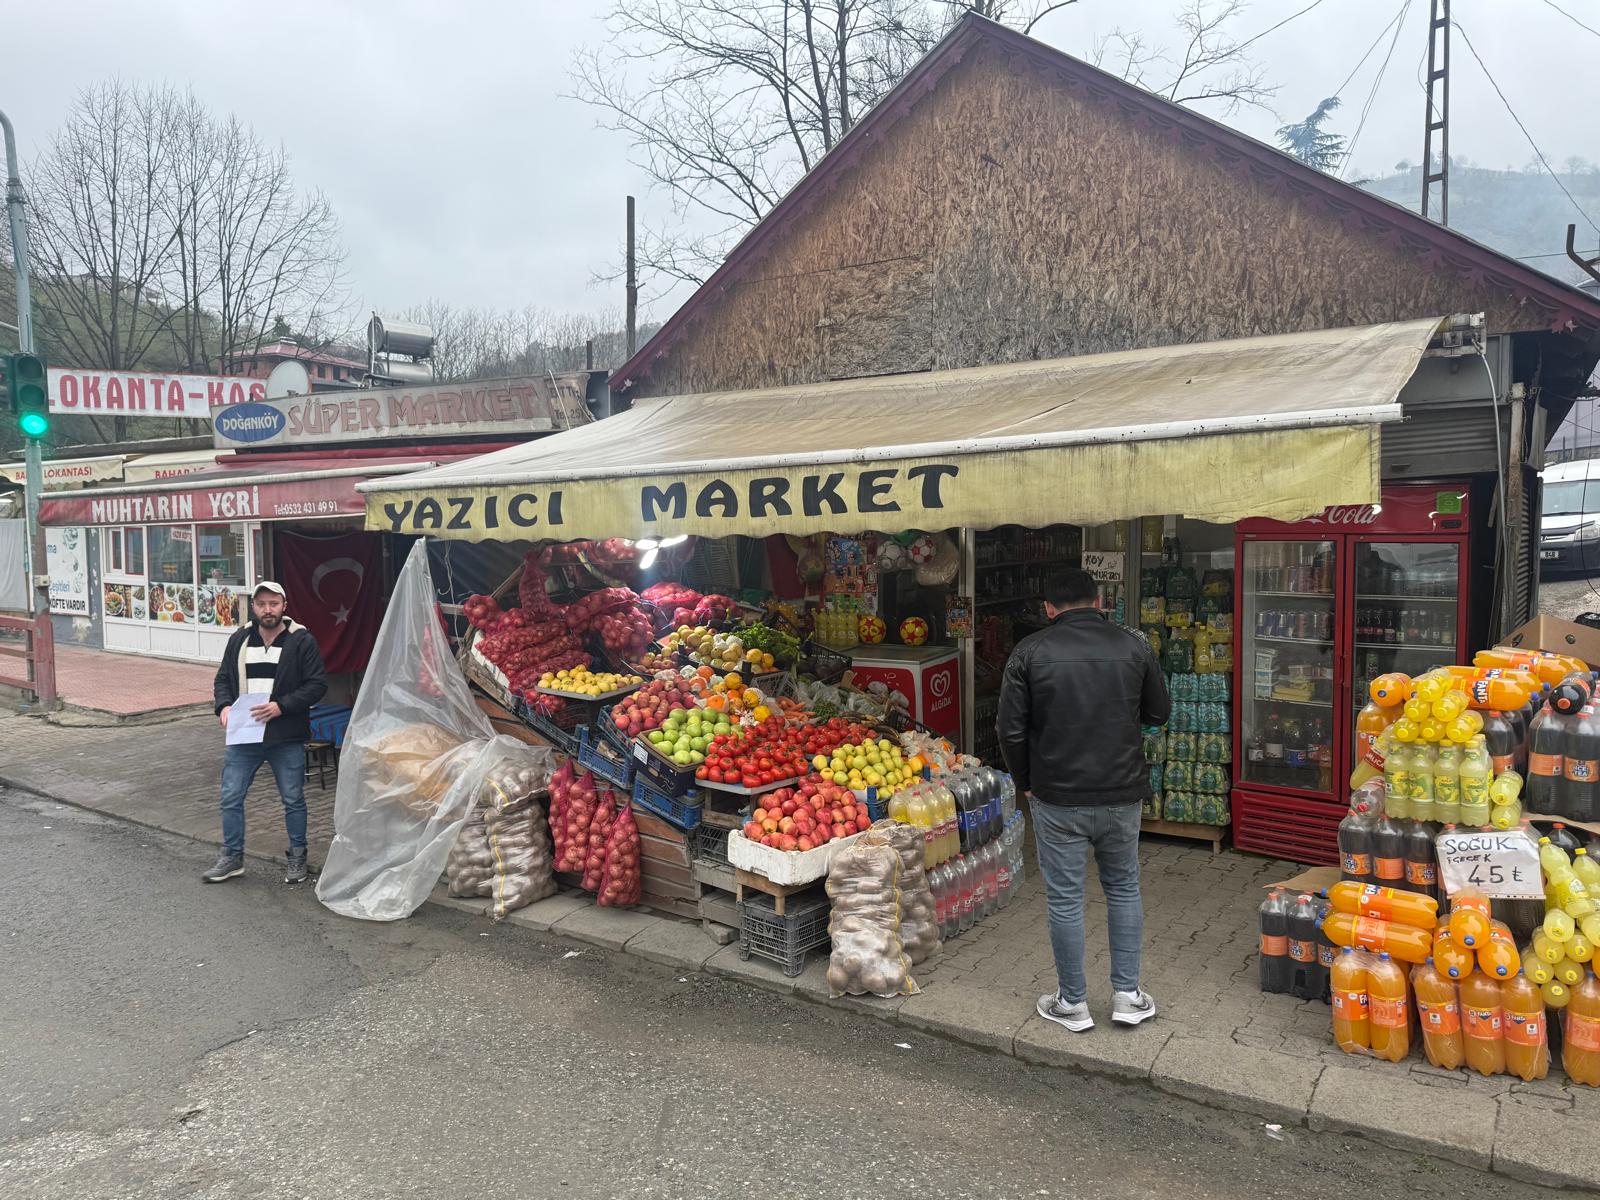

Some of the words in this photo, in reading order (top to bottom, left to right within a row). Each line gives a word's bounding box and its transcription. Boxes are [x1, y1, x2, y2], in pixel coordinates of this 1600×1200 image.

[222, 412, 279, 431] DOĞANKÖY
[287, 397, 381, 436] SÜPER
[387, 385, 538, 428] MARKET
[43, 466, 92, 479] LOKANTASI
[641, 464, 959, 522] MARKET
[91, 494, 193, 523] MUHTARIN
[384, 491, 562, 530] YAZICI
[1477, 680, 1489, 704] FANTA
[1445, 837, 1518, 855] SOĞUK
[1468, 864, 1504, 887] 45
